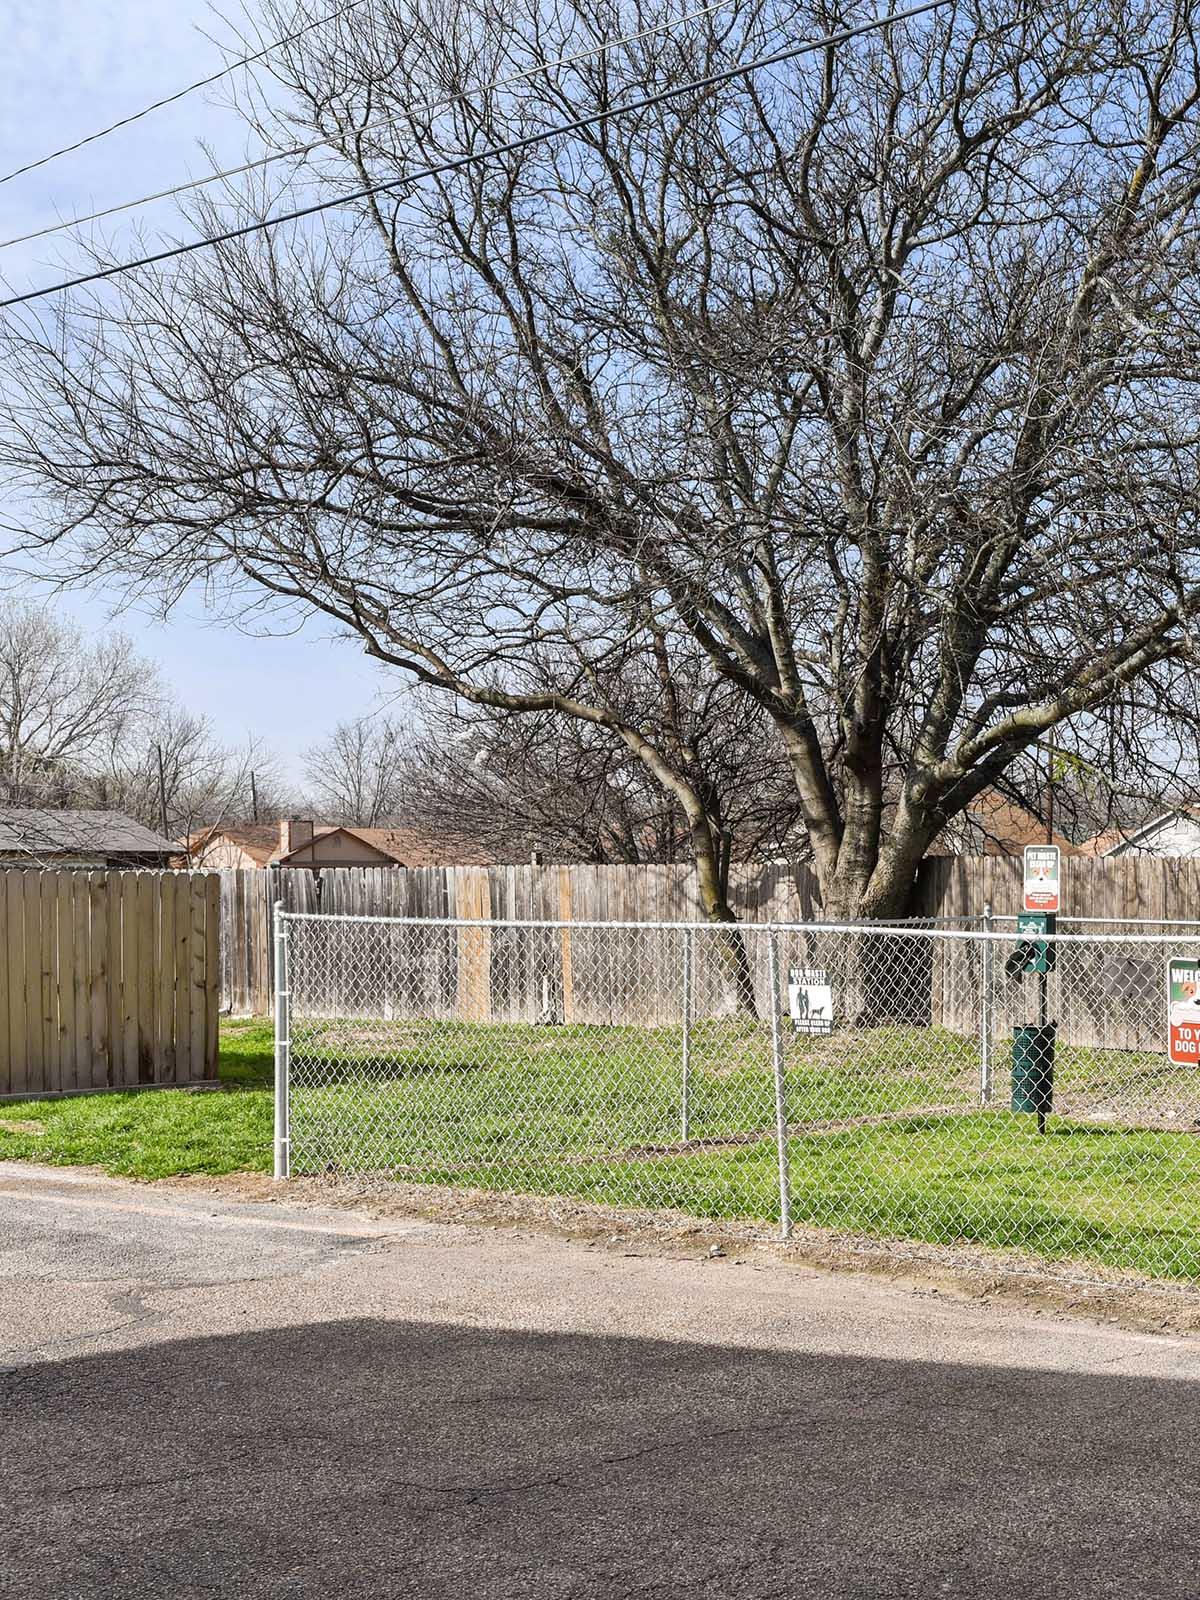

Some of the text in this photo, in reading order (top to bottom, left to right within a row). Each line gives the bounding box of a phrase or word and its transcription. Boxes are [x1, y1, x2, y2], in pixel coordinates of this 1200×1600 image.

[804, 969, 826, 978] WASTE
[793, 977, 825, 985] STATION
[1178, 1027, 1192, 1040] TO
[1174, 1040, 1196, 1053] DOG
